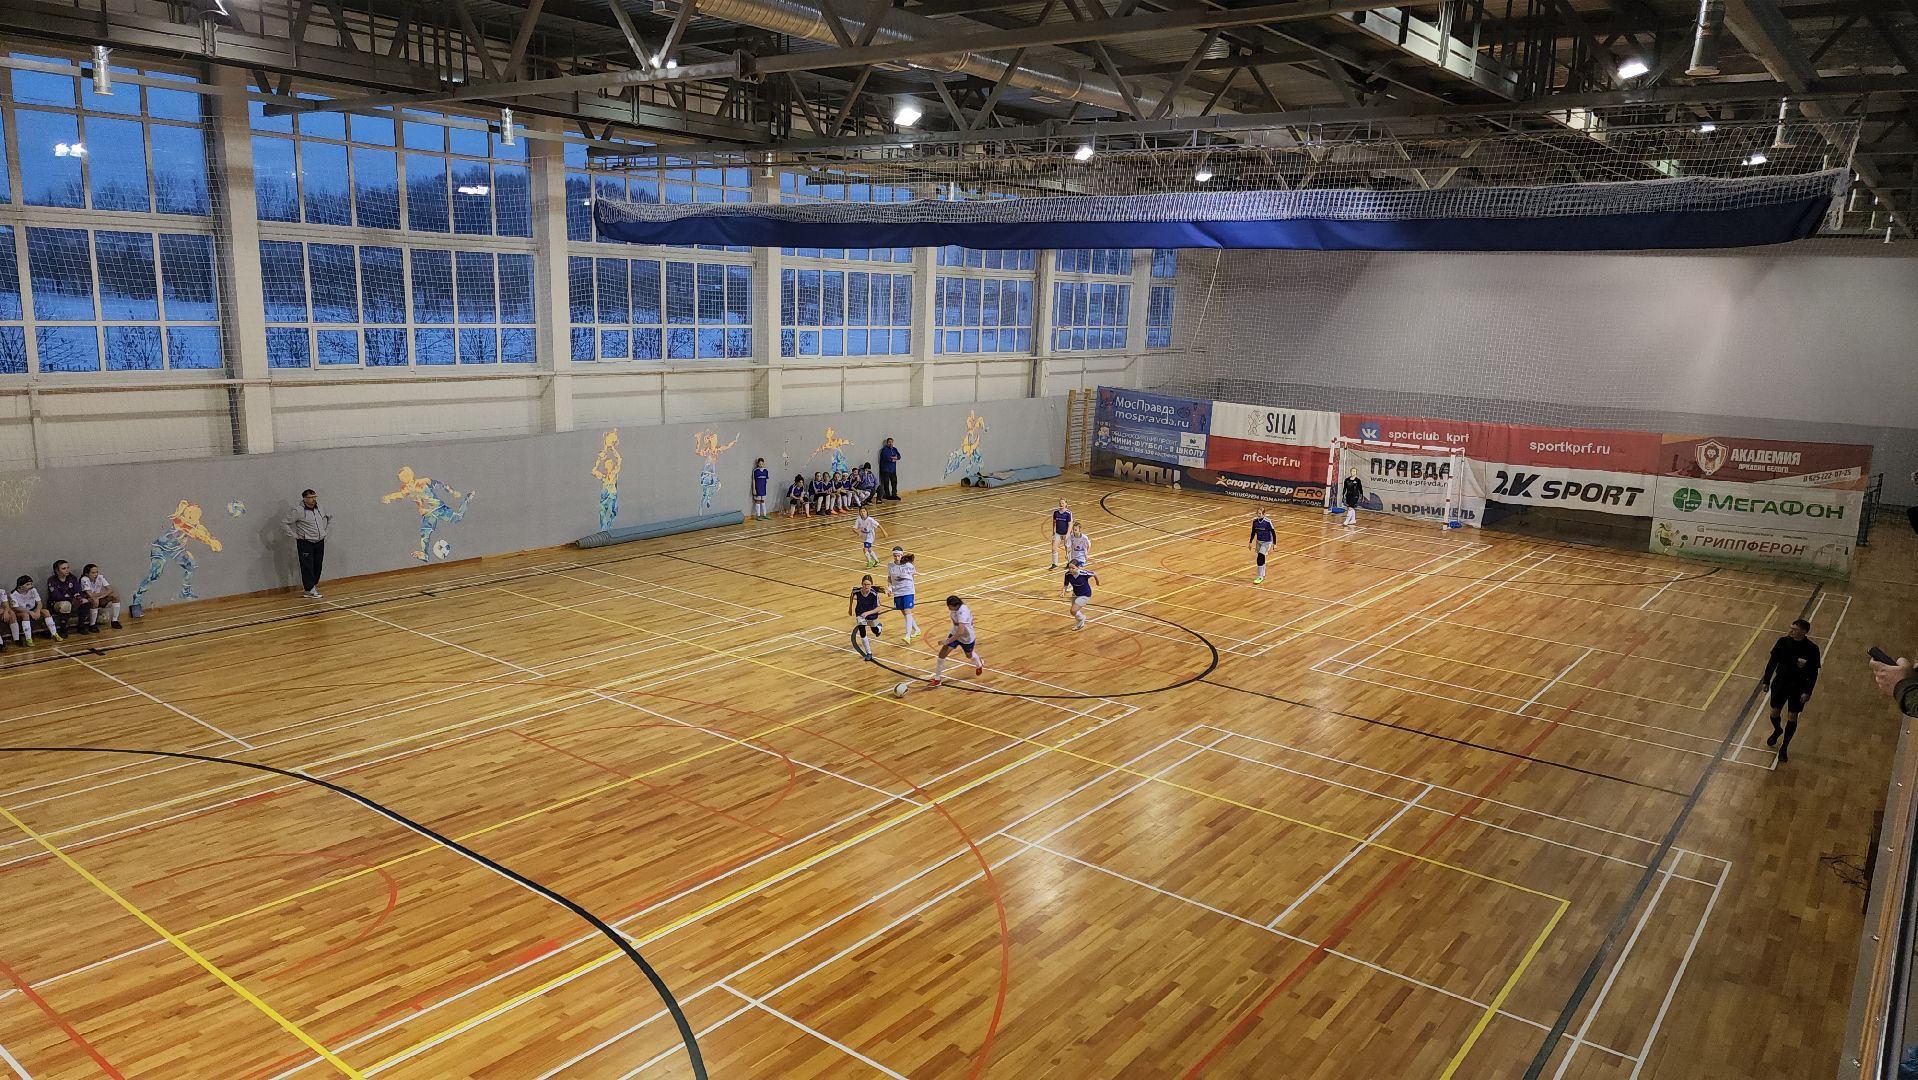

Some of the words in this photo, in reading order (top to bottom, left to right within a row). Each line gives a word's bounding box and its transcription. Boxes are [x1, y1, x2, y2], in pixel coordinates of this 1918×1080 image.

[1115, 396, 1175, 415] МосПравда
[1115, 410, 1190, 428] mospravda.ru
[1266, 412, 1296, 435] SILA
[1112, 436, 1163, 450] МИНИ-ФУТБОЛ
[1176, 447, 1205, 457] ШКОЛУ
[1530, 441, 1611, 455] sportkprf.ru
[1242, 452, 1301, 468] mfc-kprf.ru
[1731, 448, 1801, 466] АКАДЕМИЯ
[1370, 457, 1450, 481] ПРАВДА
[1370, 477, 1449, 488] www.gazeta-pravda.r
[1492, 471, 1541, 498] 2K
[1541, 480, 1645, 506] SPORT
[1295, 488, 1323, 498] PRO
[1708, 493, 1845, 519] МЕГАФОН
[1693, 536, 1806, 556] ГРИППФЕРОН
